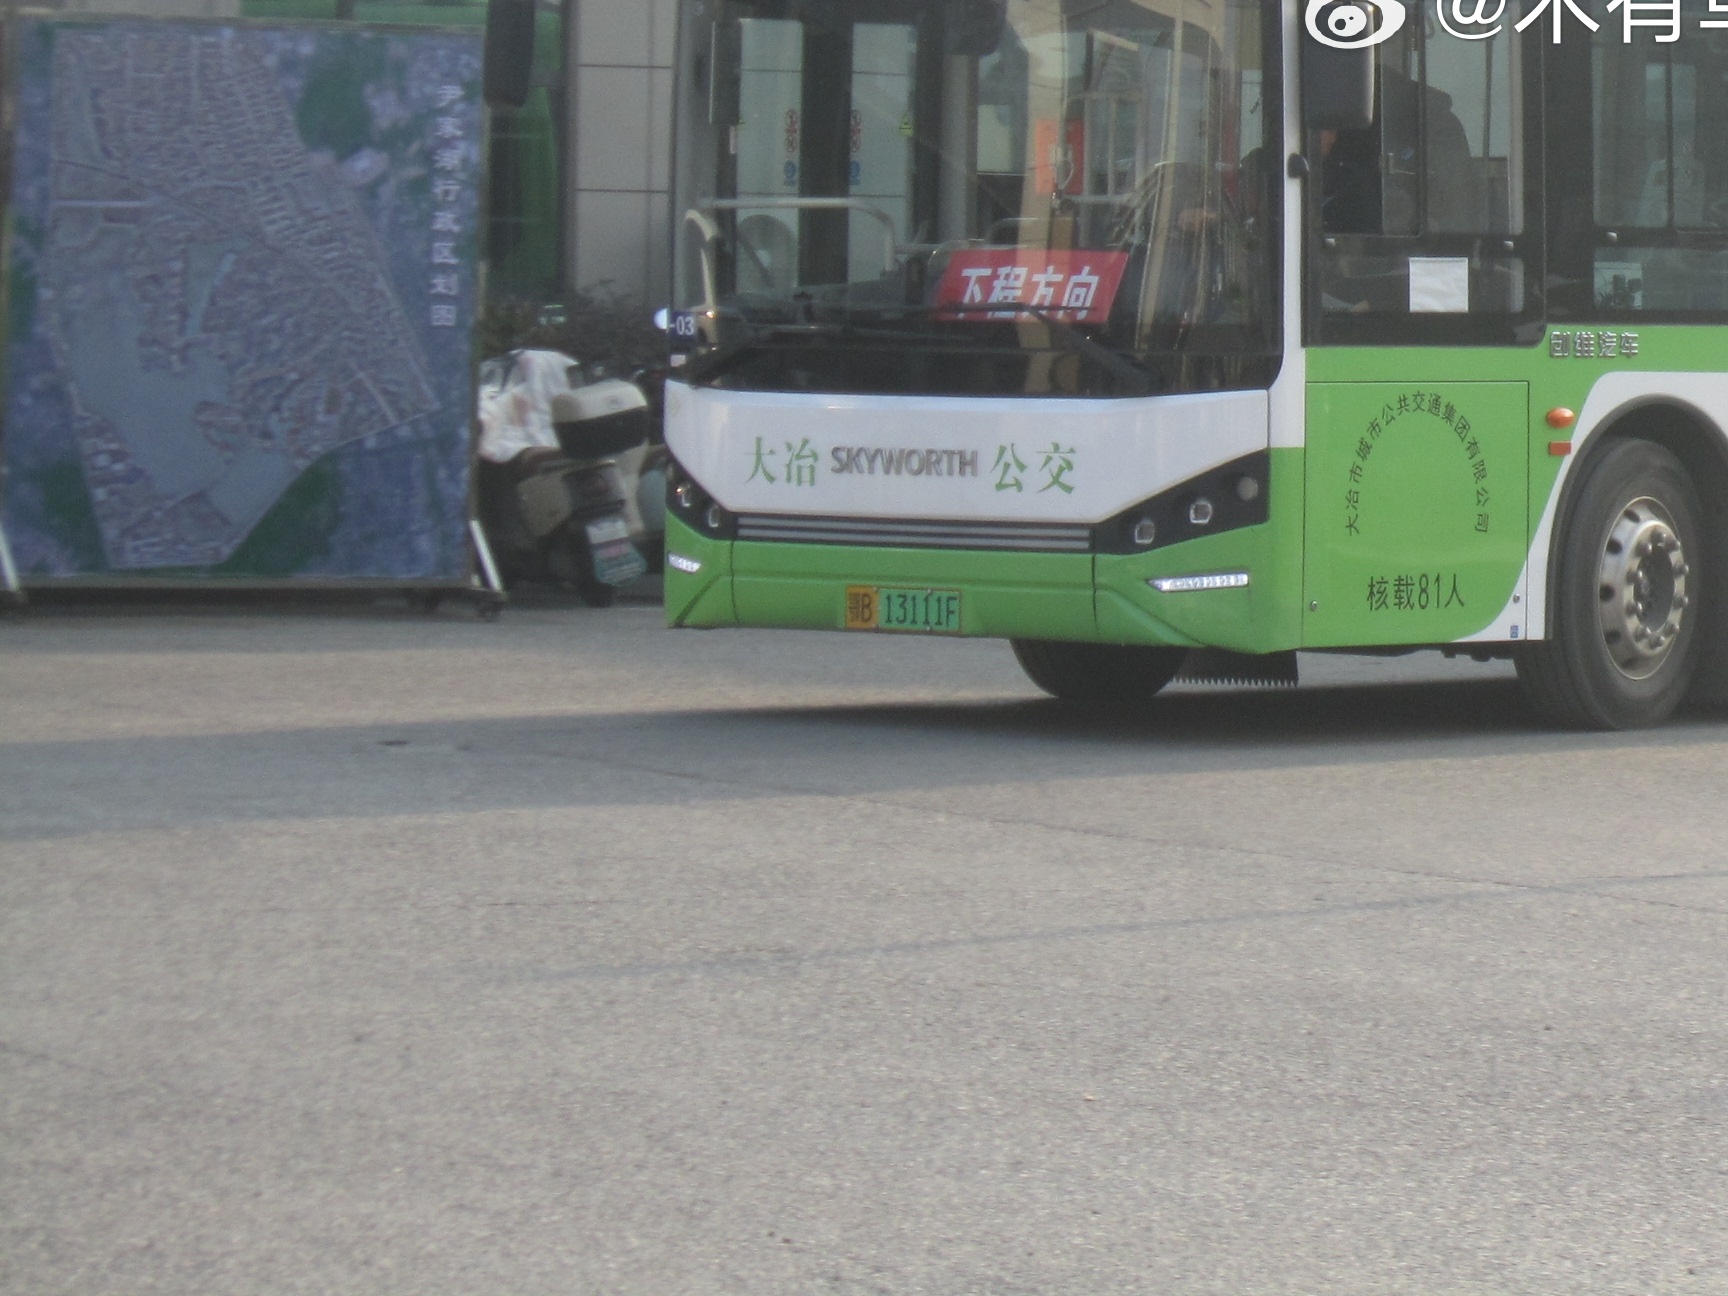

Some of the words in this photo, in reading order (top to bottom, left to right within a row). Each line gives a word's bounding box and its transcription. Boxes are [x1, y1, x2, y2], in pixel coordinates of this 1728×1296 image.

[745, 436, 819, 487] 大冶
[830, 446, 978, 478] SKYWORTH
[990, 442, 1076, 494] 公交
[1345, 390, 1490, 537] 大冶市城市公共交通集团有限公司
[1366, 573, 1465, 611] 核载81人
